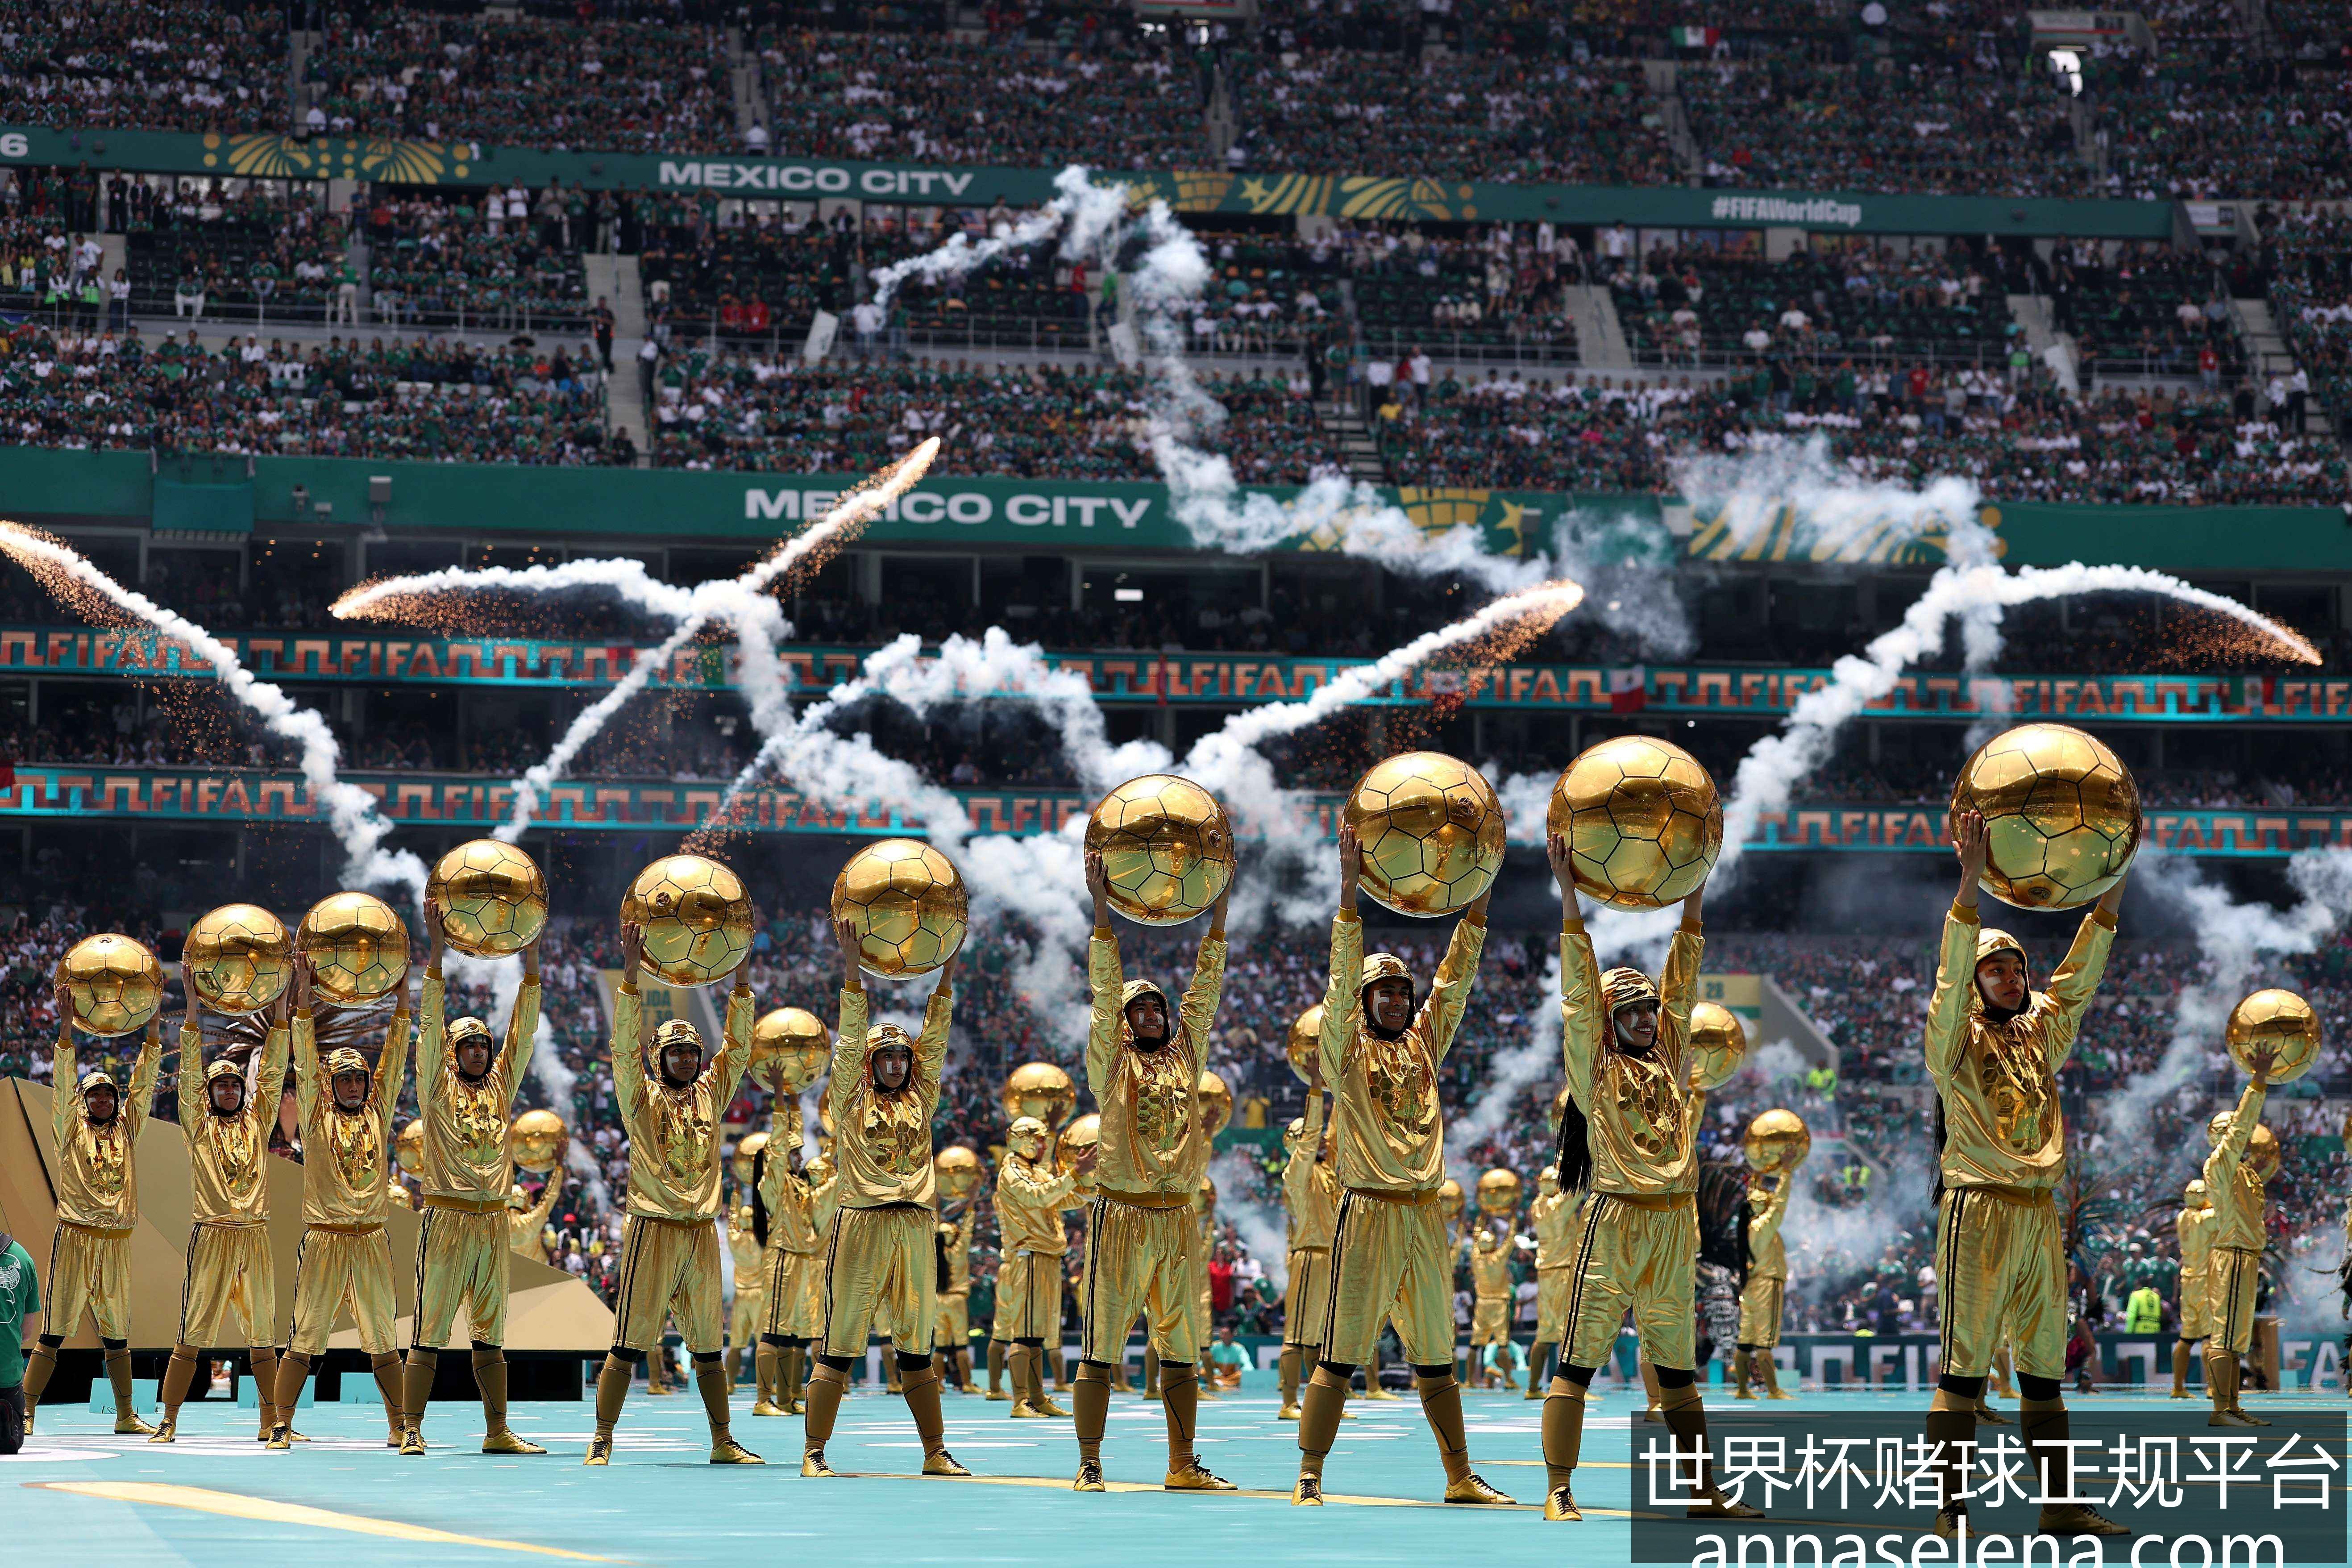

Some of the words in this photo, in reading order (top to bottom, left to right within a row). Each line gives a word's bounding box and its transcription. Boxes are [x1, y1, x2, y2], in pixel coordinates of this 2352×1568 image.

[0, 133, 29, 157] 6
[659, 161, 851, 192] MEXICO
[861, 168, 974, 196] CITY
[1712, 196, 1862, 227] #FIFAWorldCup
[745, 488, 993, 524] MEICO
[1005, 493, 1152, 529] CITY
[48, 632, 147, 670] FIFA
[341, 641, 436, 676] FIFA
[1191, 662, 1290, 696] FIFA
[1467, 668, 1561, 702] FIFA
[2013, 679, 2108, 714] FIFA
[152, 777, 253, 814] FIFA
[732, 792, 828, 828] FIFA
[1014, 799, 1096, 832] FIF
[1841, 812, 1935, 845] FIFA
